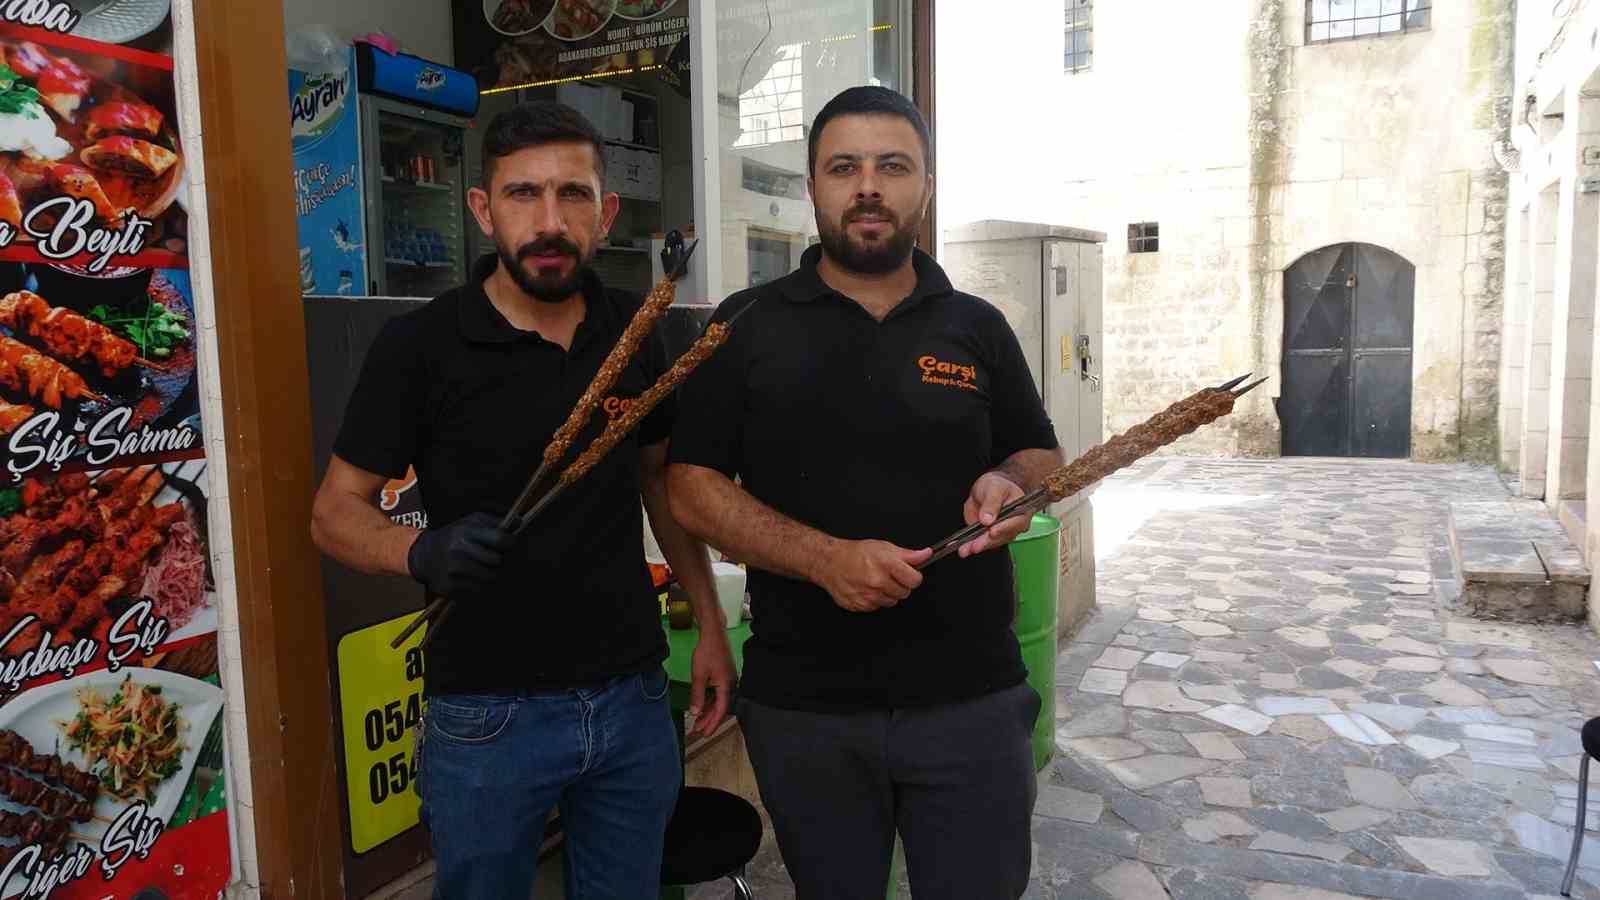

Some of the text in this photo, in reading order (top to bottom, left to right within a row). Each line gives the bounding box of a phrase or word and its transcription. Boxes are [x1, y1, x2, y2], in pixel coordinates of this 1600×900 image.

[291, 78, 345, 127] Ayran
[24, 196, 153, 272] Beyti
[8, 407, 196, 482] Şiş Sarma
[0, 601, 168, 692] uşbaşı Şiş
[365, 692, 424, 752] 054
[102, 803, 162, 879] Şiş
